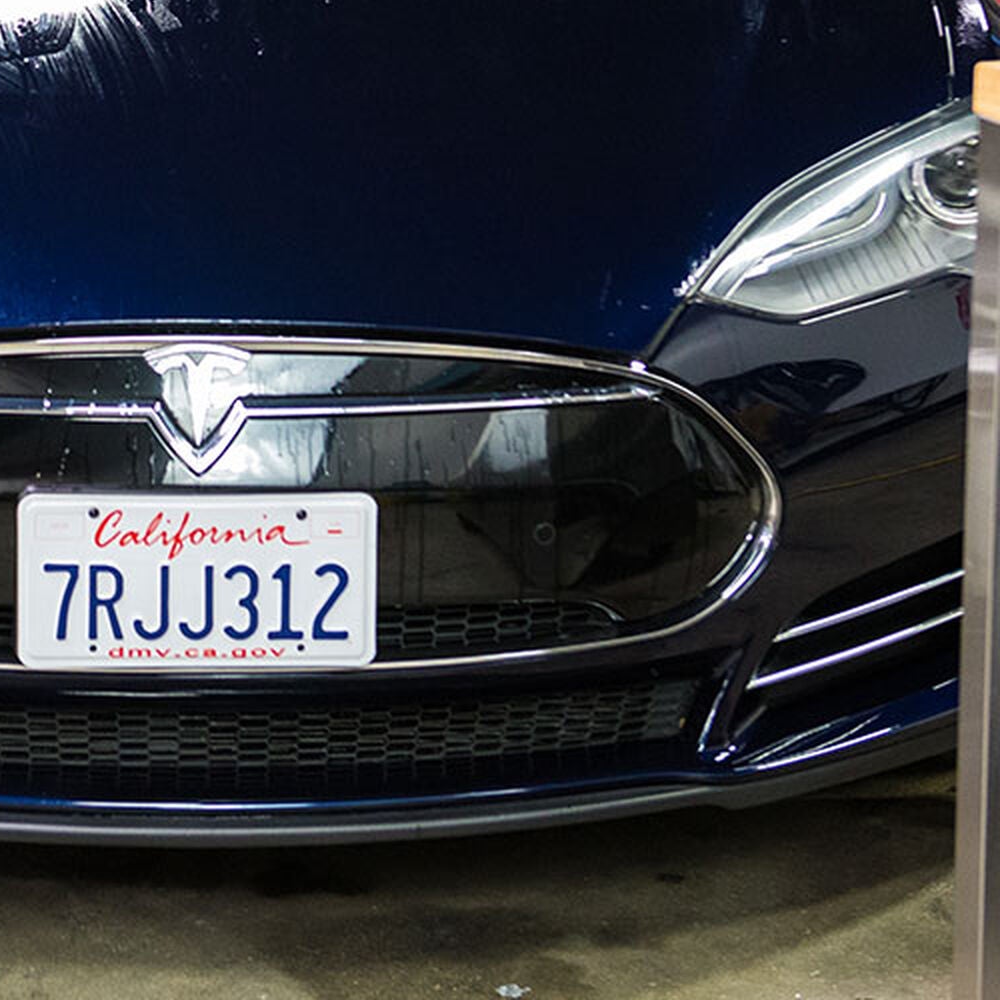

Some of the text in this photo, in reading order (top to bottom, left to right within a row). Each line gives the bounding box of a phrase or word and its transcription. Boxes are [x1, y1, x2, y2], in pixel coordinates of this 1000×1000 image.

[93, 508, 310, 560] California
[43, 563, 349, 641] 7RJJ312
[108, 646, 285, 660] dmv.ca.gov
